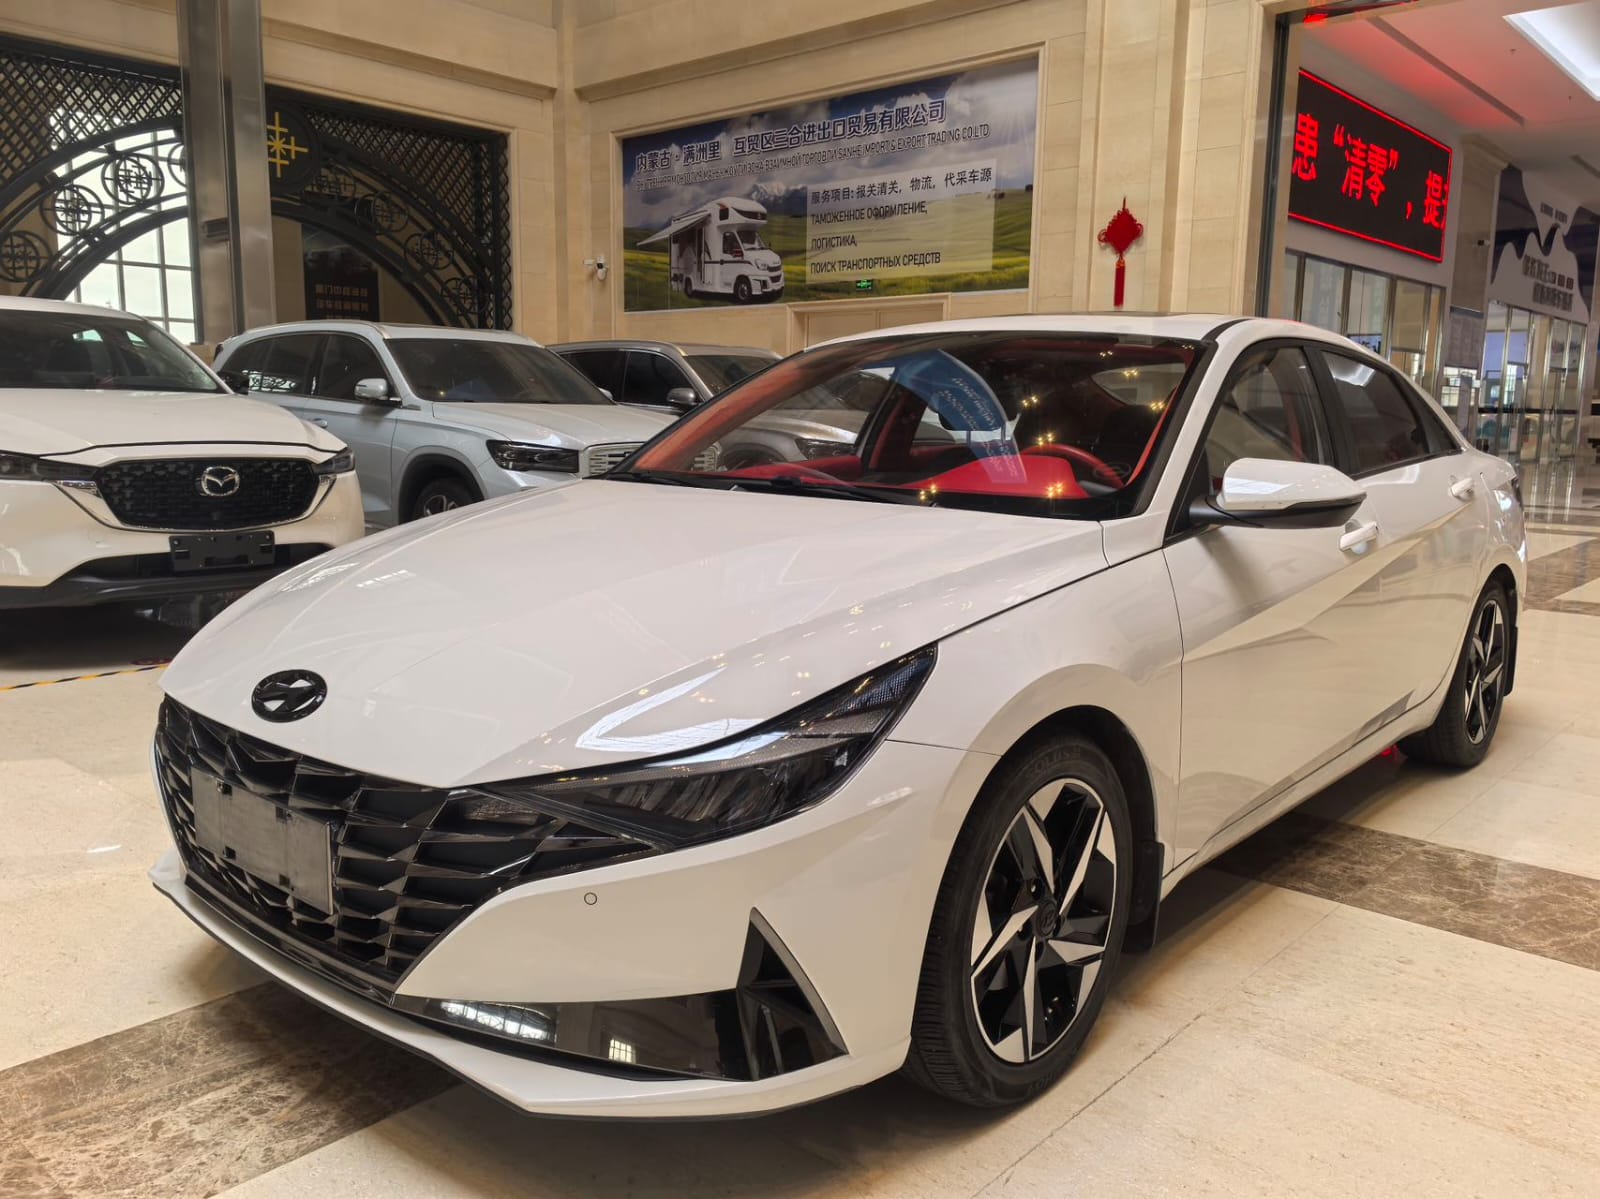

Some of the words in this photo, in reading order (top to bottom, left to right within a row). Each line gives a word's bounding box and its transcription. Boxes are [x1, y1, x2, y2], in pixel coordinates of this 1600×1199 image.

[734, 99, 946, 154] 互贸区三合进出口贸易有限公司
[838, 143, 862, 160] SANHE
[863, 140, 890, 157] IMPORT
[890, 141, 896, 151] &
[897, 134, 926, 151] EXPORT
[927, 128, 960, 145] TRADING
[811, 207, 866, 225] ТАМОЖЕННОЕ
[811, 259, 836, 274] ПОИСК
[837, 255, 901, 273] ТРАНСПОРТНЫХ
[902, 251, 941, 267] СРЕДСТВ
